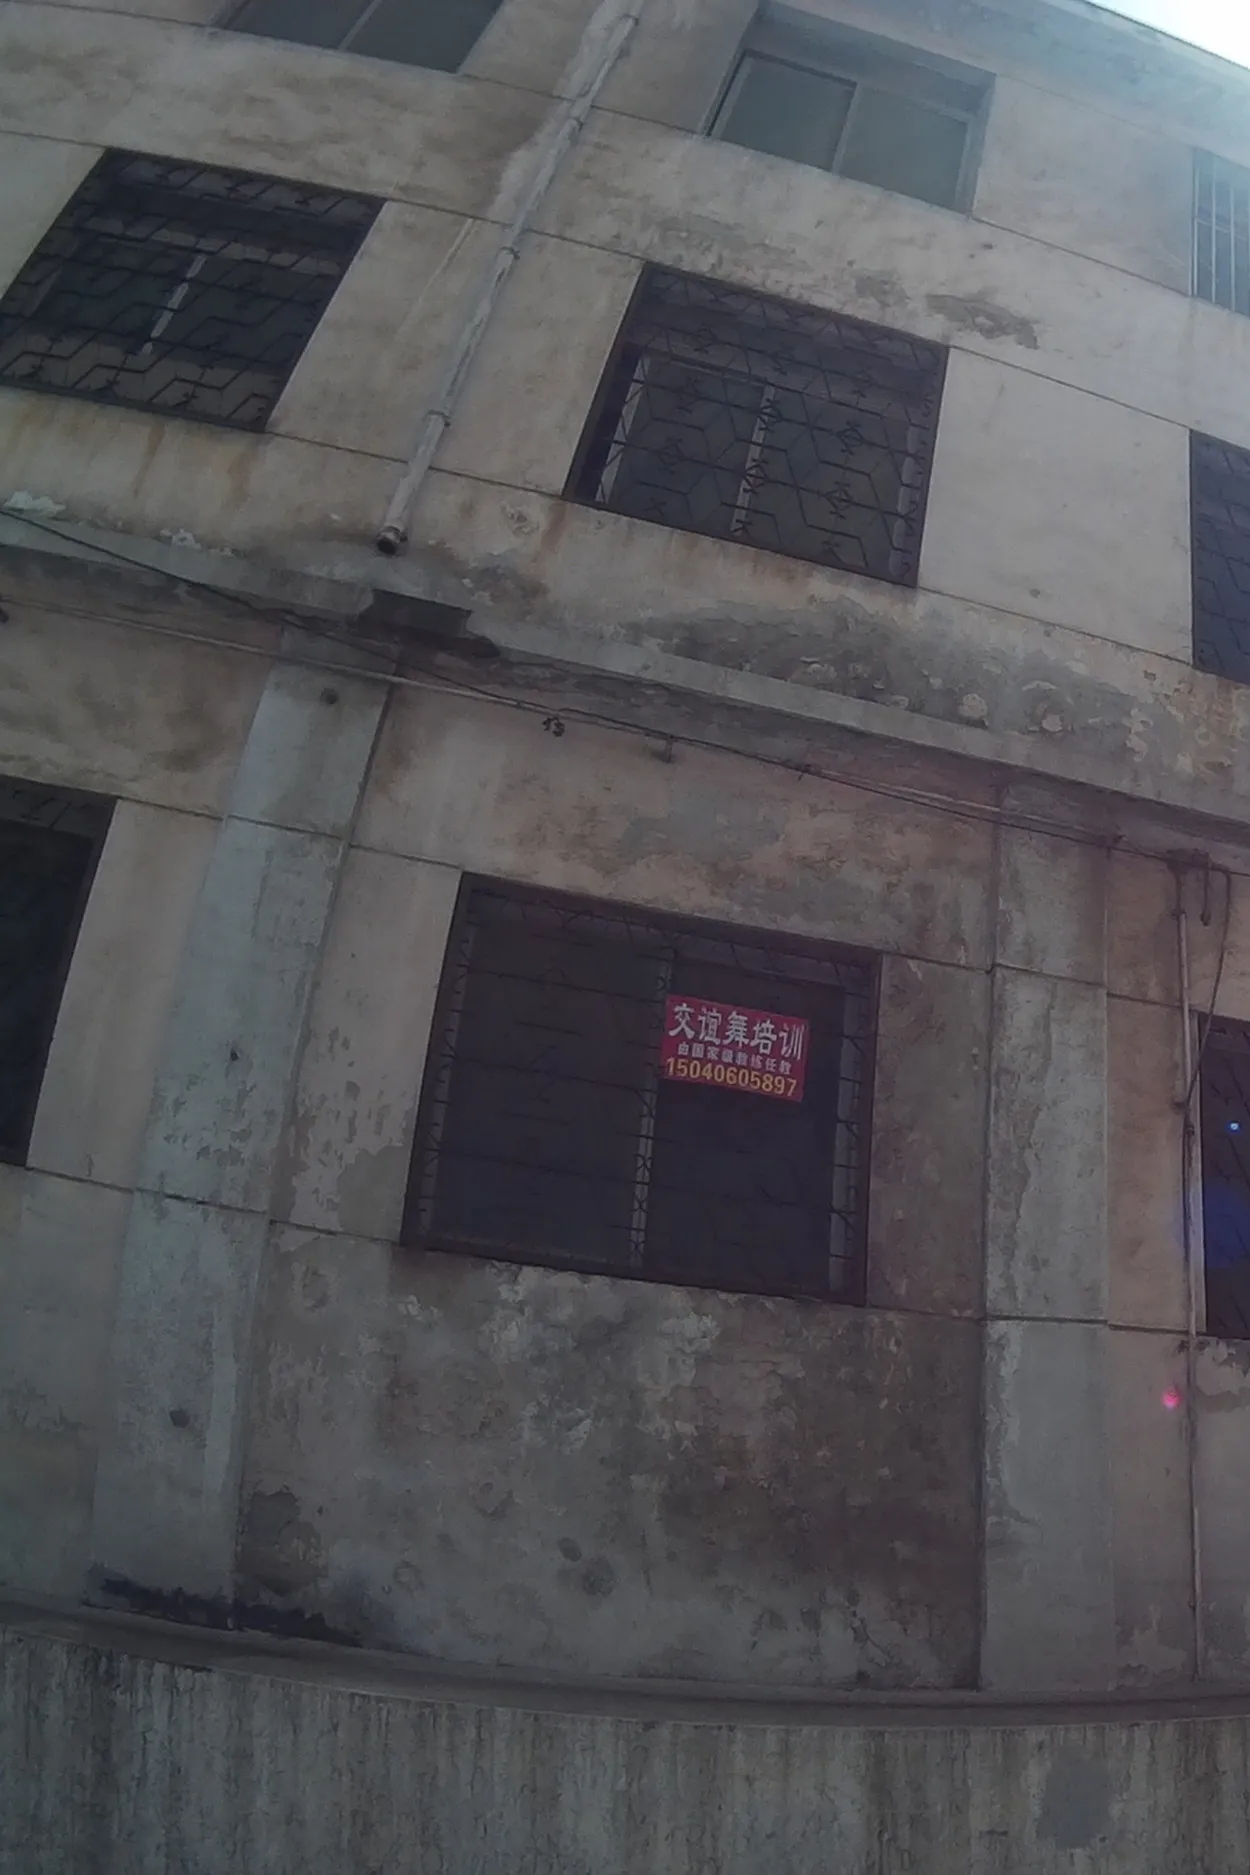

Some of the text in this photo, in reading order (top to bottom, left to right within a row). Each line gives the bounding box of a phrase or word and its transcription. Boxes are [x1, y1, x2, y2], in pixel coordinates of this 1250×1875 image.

[669, 1002, 805, 1061] 交谊舞培训
[667, 1057, 797, 1097] 15040605897
